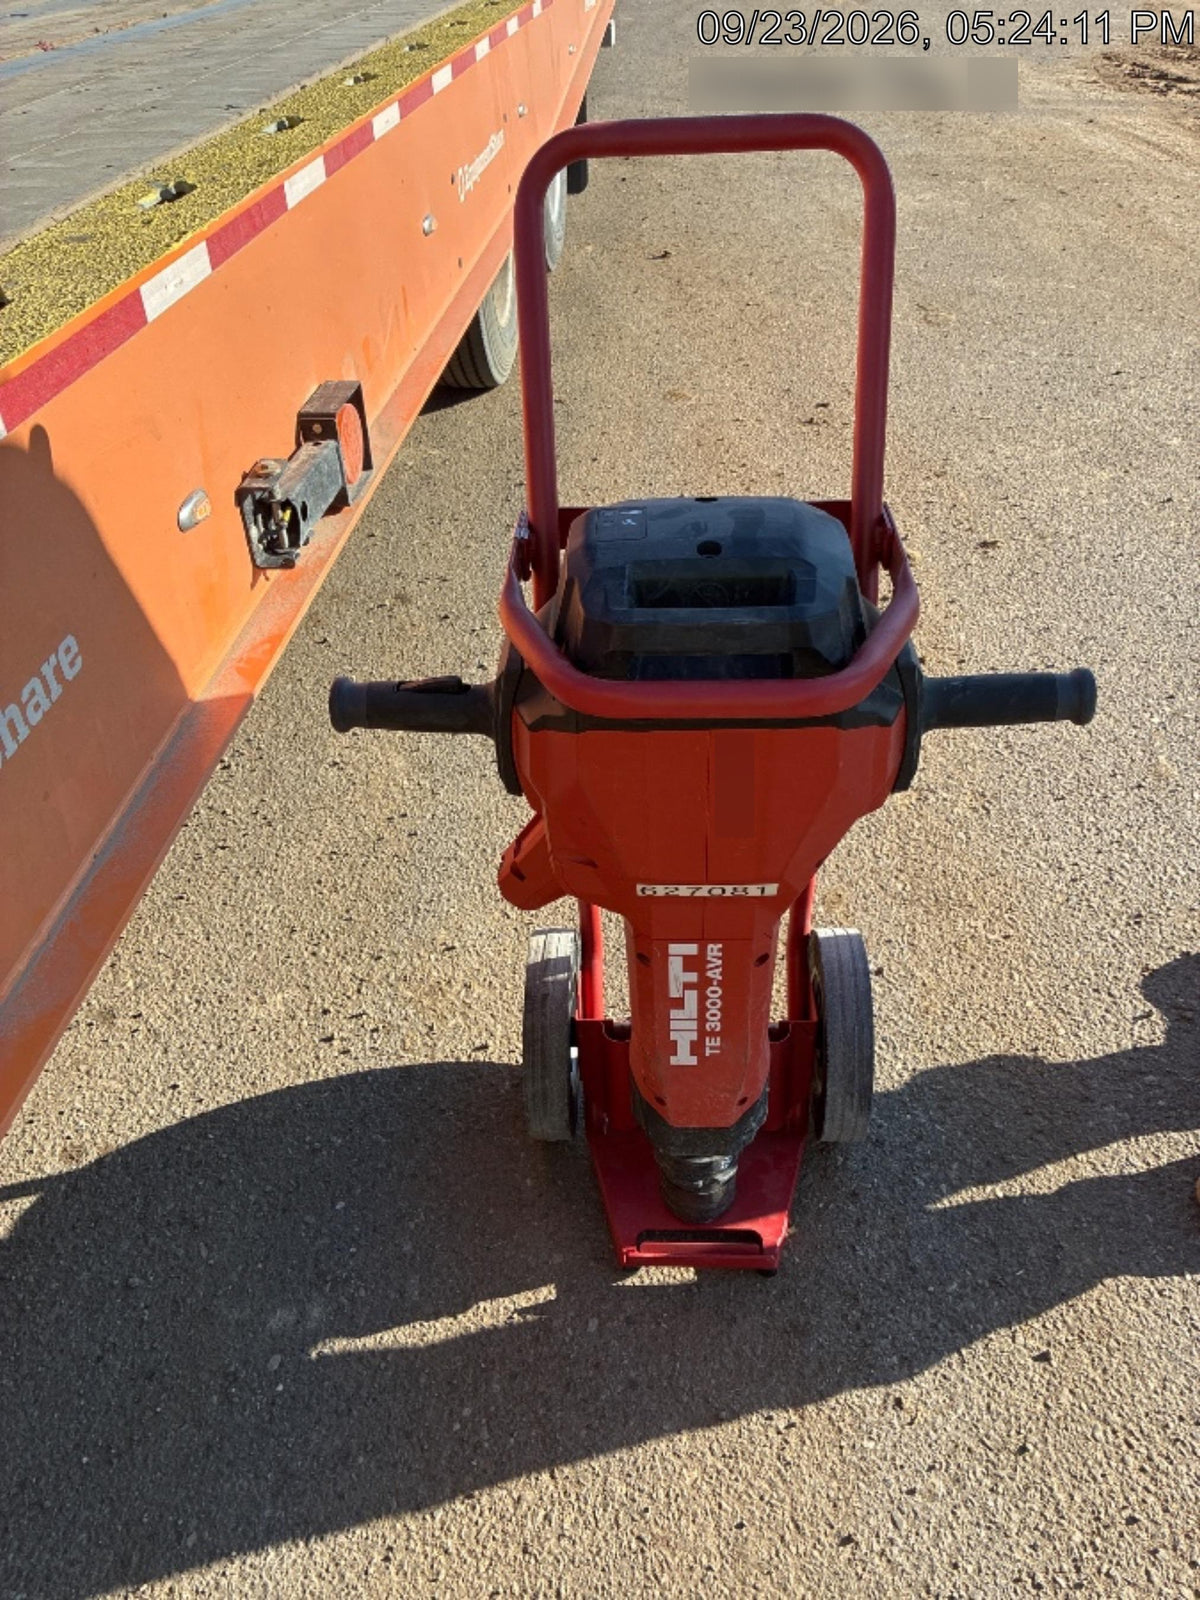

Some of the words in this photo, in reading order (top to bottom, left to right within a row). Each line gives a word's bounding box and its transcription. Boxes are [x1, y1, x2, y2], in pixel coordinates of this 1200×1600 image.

[639, 885, 769, 896] 627081
[668, 943, 698, 1065] HILTI
[705, 943, 723, 1032] 3000-AVR
[705, 1036, 721, 1057] TE
